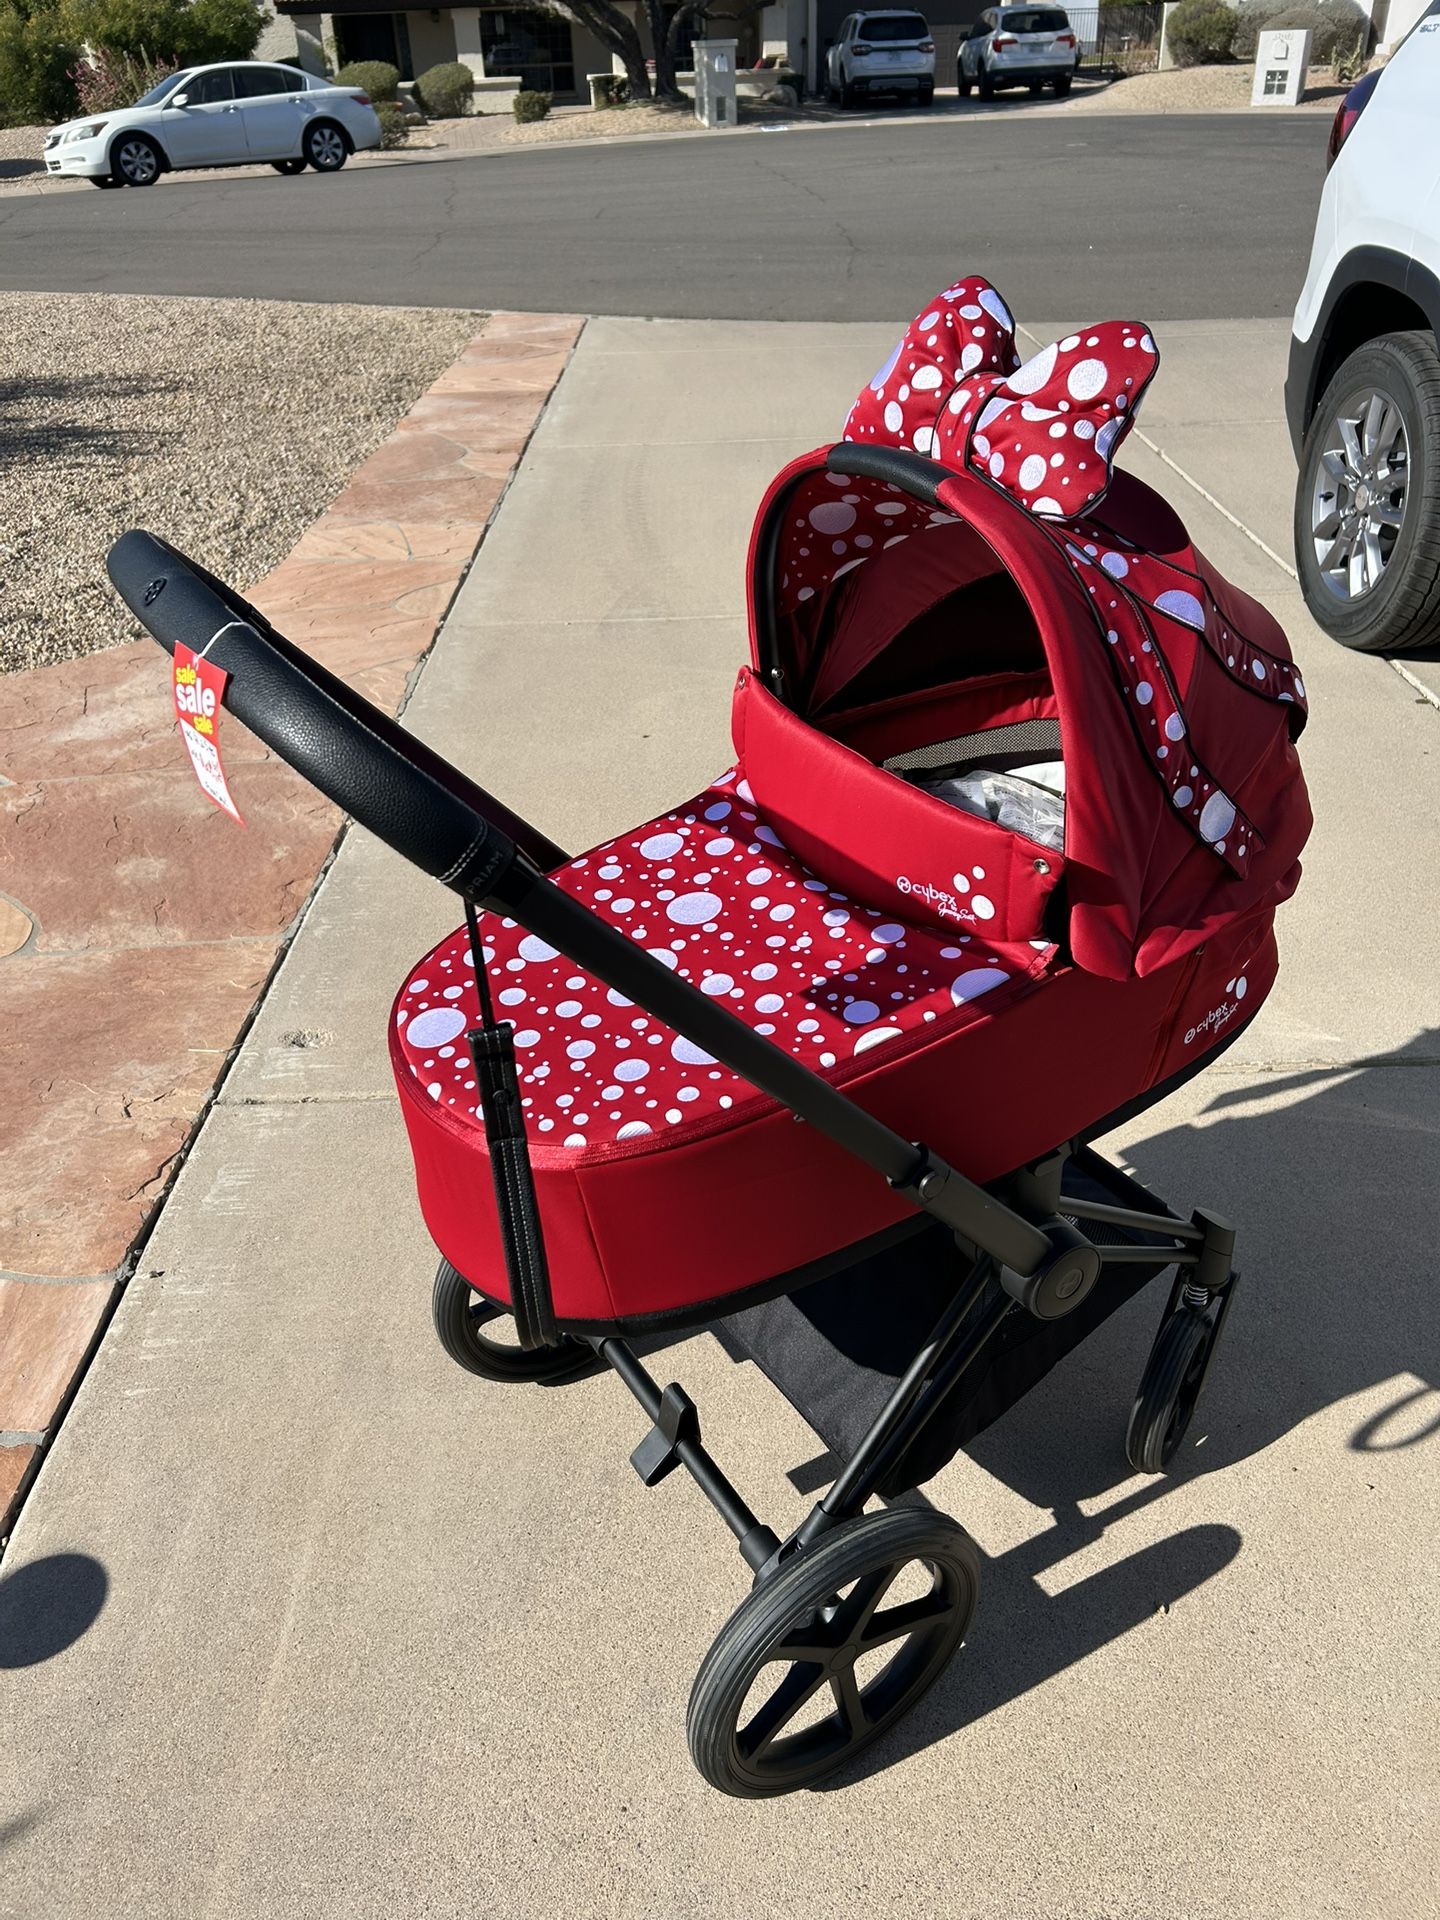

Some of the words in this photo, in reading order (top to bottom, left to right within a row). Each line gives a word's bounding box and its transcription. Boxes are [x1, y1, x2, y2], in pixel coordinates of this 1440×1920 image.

[176, 665, 197, 685] sale
[175, 677, 216, 718] sale
[193, 715, 213, 735] sale
[465, 850, 504, 895] PRIAM
[912, 883, 956, 904] cybex
[1196, 1001, 1229, 1031] cybex
